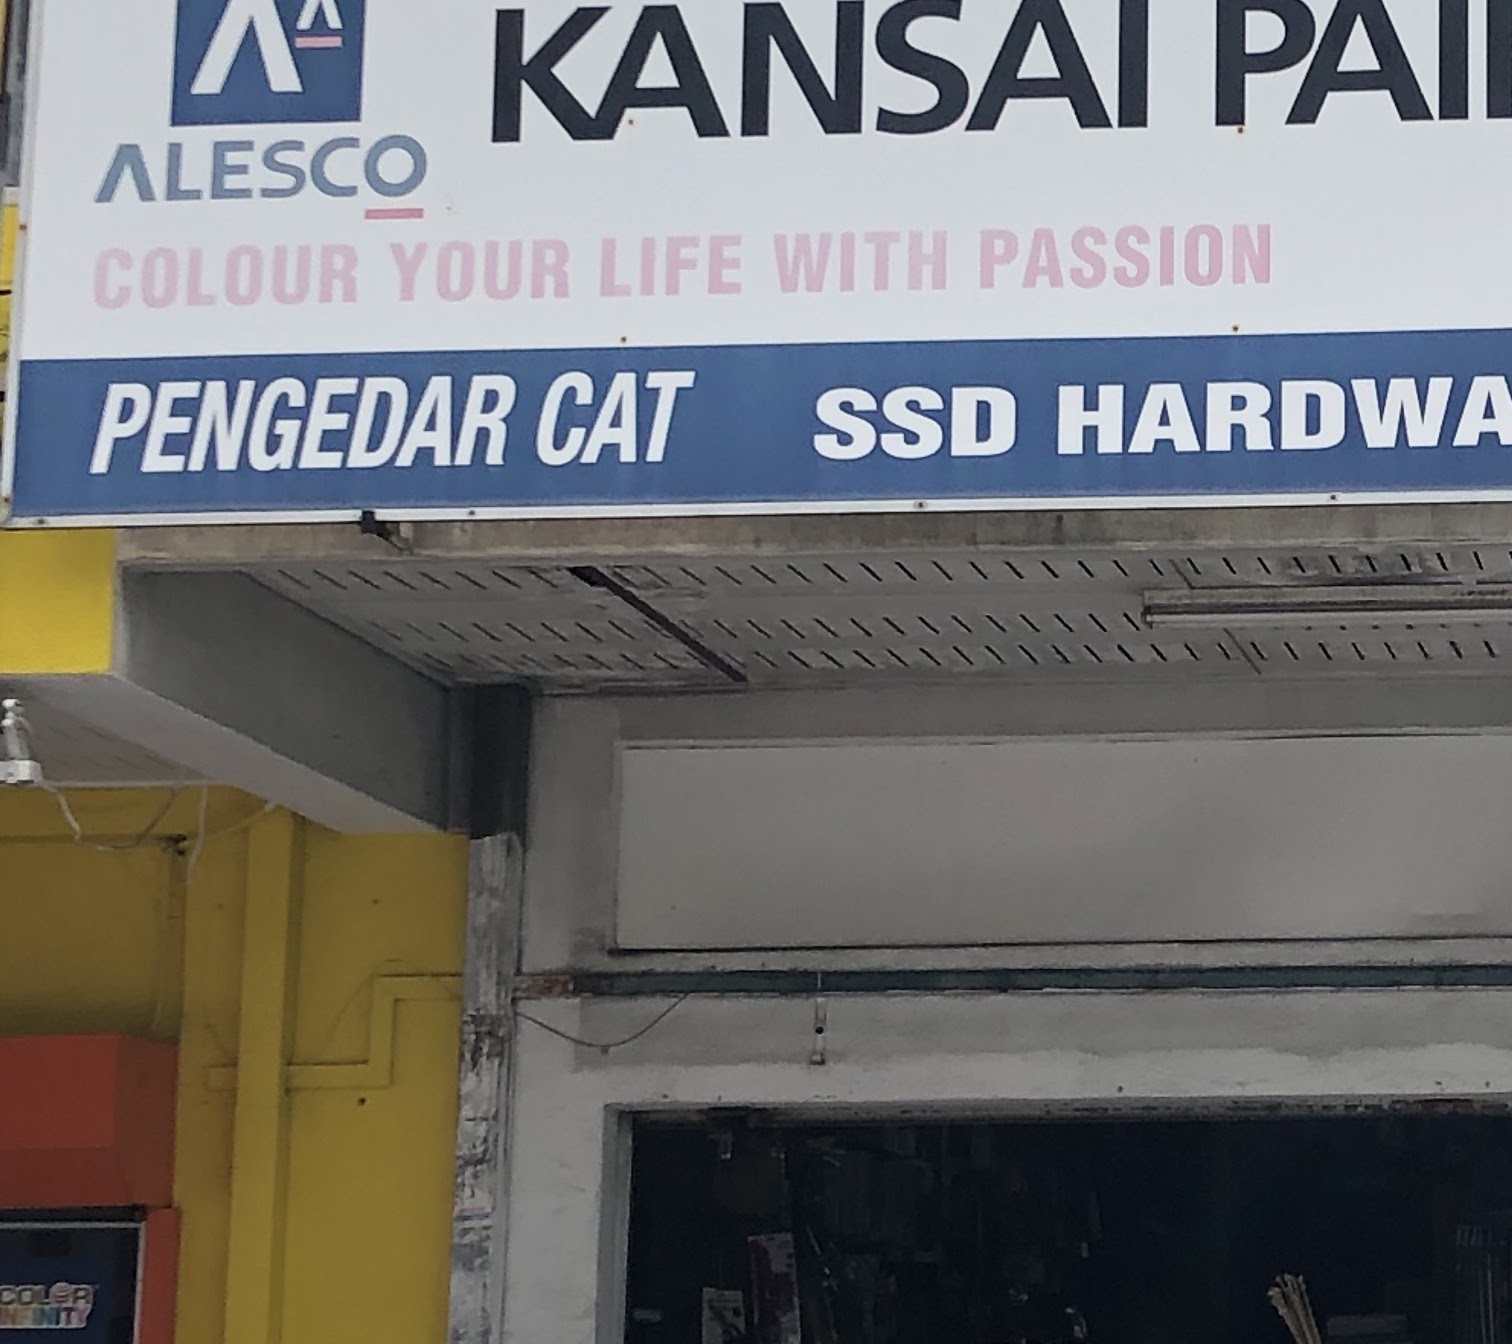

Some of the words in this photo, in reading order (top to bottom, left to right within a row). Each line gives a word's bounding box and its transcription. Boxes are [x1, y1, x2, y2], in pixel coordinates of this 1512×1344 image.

[94, 134, 428, 204] ALESCO
[93, 244, 359, 310] COLOUR
[389, 238, 570, 302] YOUR
[599, 234, 742, 298] LIFE
[773, 230, 948, 294] WITH
[979, 223, 1271, 289] PASSION
[90, 374, 516, 475] PENGEDAR
[536, 371, 696, 466] CAT
[813, 386, 1016, 460] SSD
